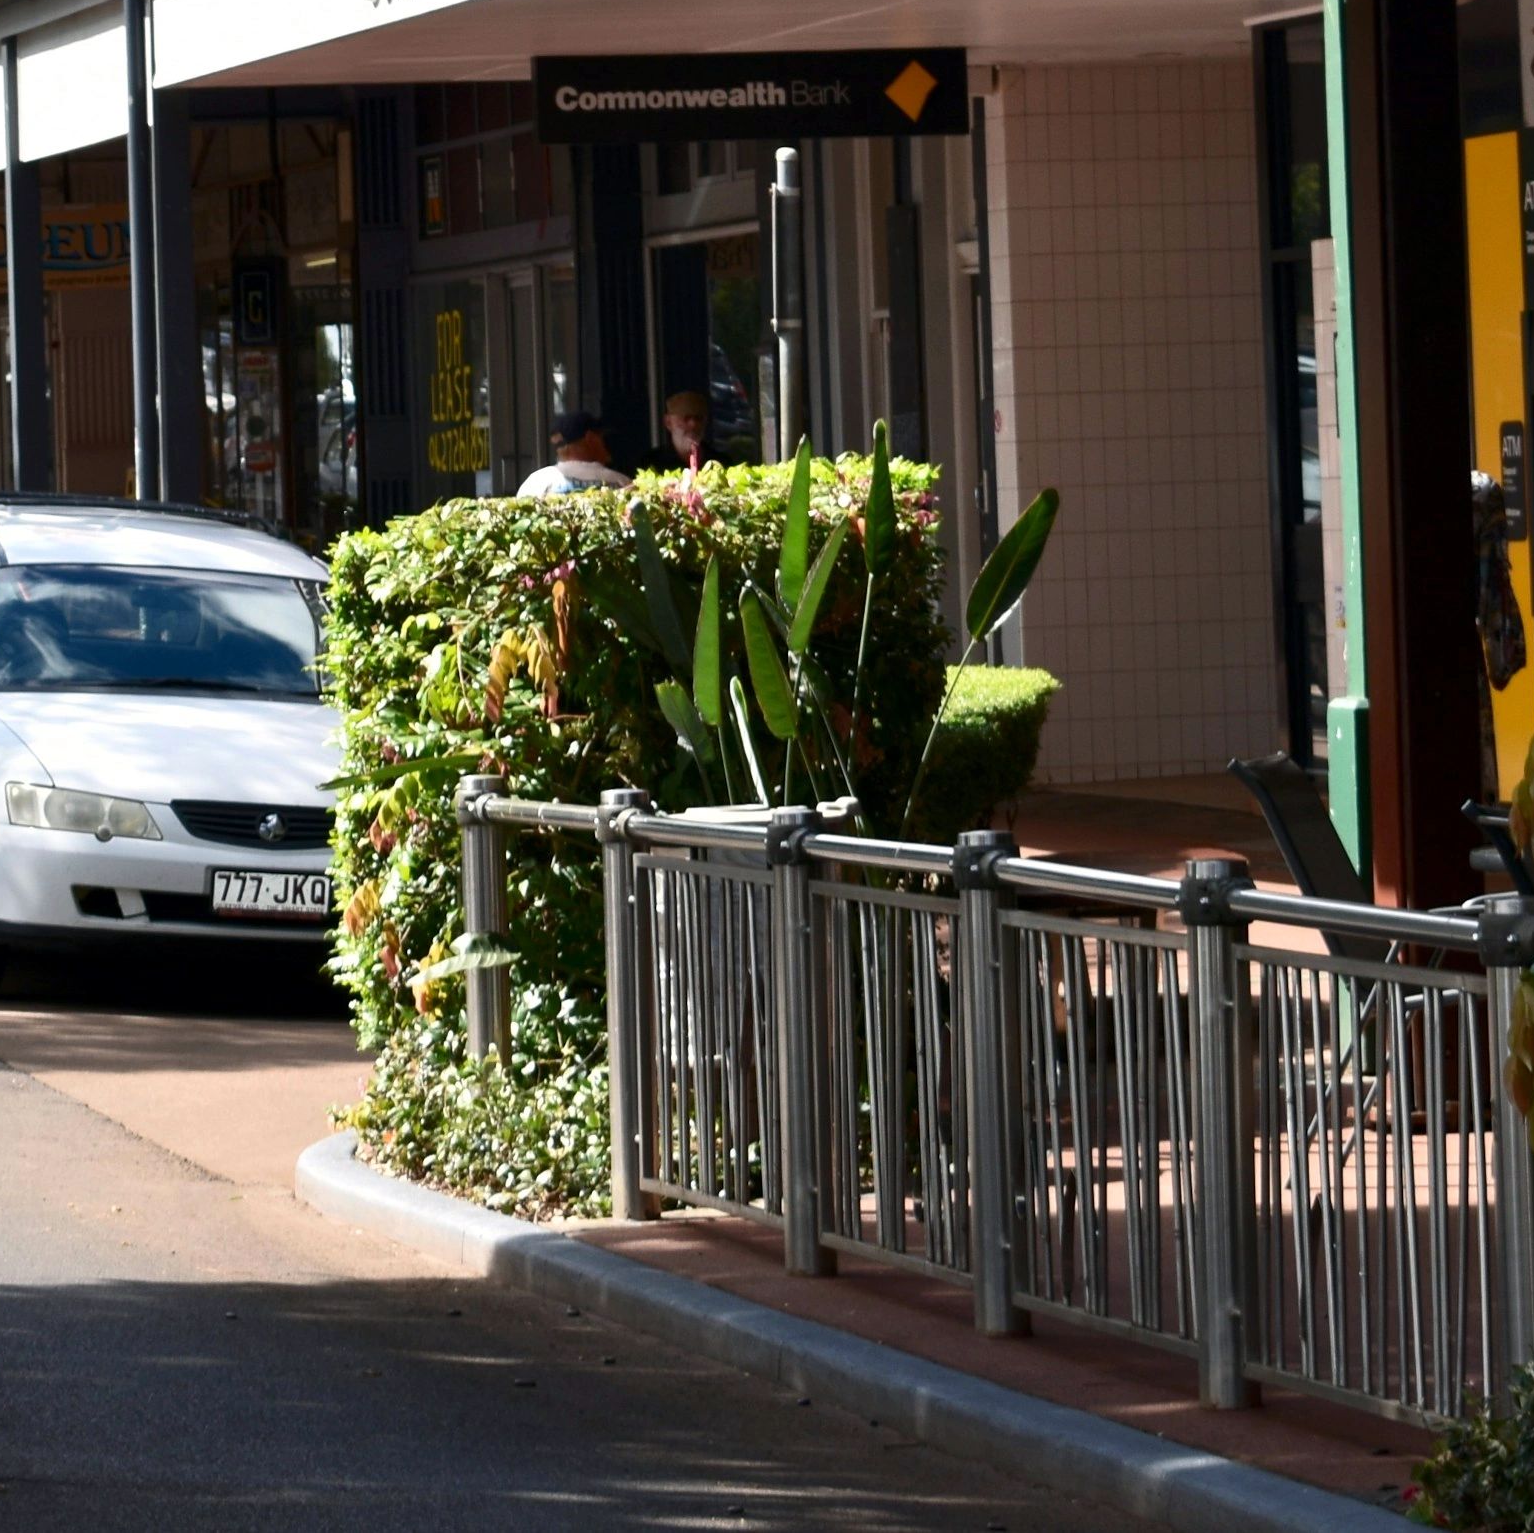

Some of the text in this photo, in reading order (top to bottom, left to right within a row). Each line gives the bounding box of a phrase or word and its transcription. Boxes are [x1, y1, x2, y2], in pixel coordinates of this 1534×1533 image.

[555, 80, 852, 111] Commonwealth Bank
[435, 310, 463, 370] FOR
[430, 364, 473, 423] LEASE
[1503, 435, 1522, 457] ATM
[217, 875, 326, 906] 777 JKQ
